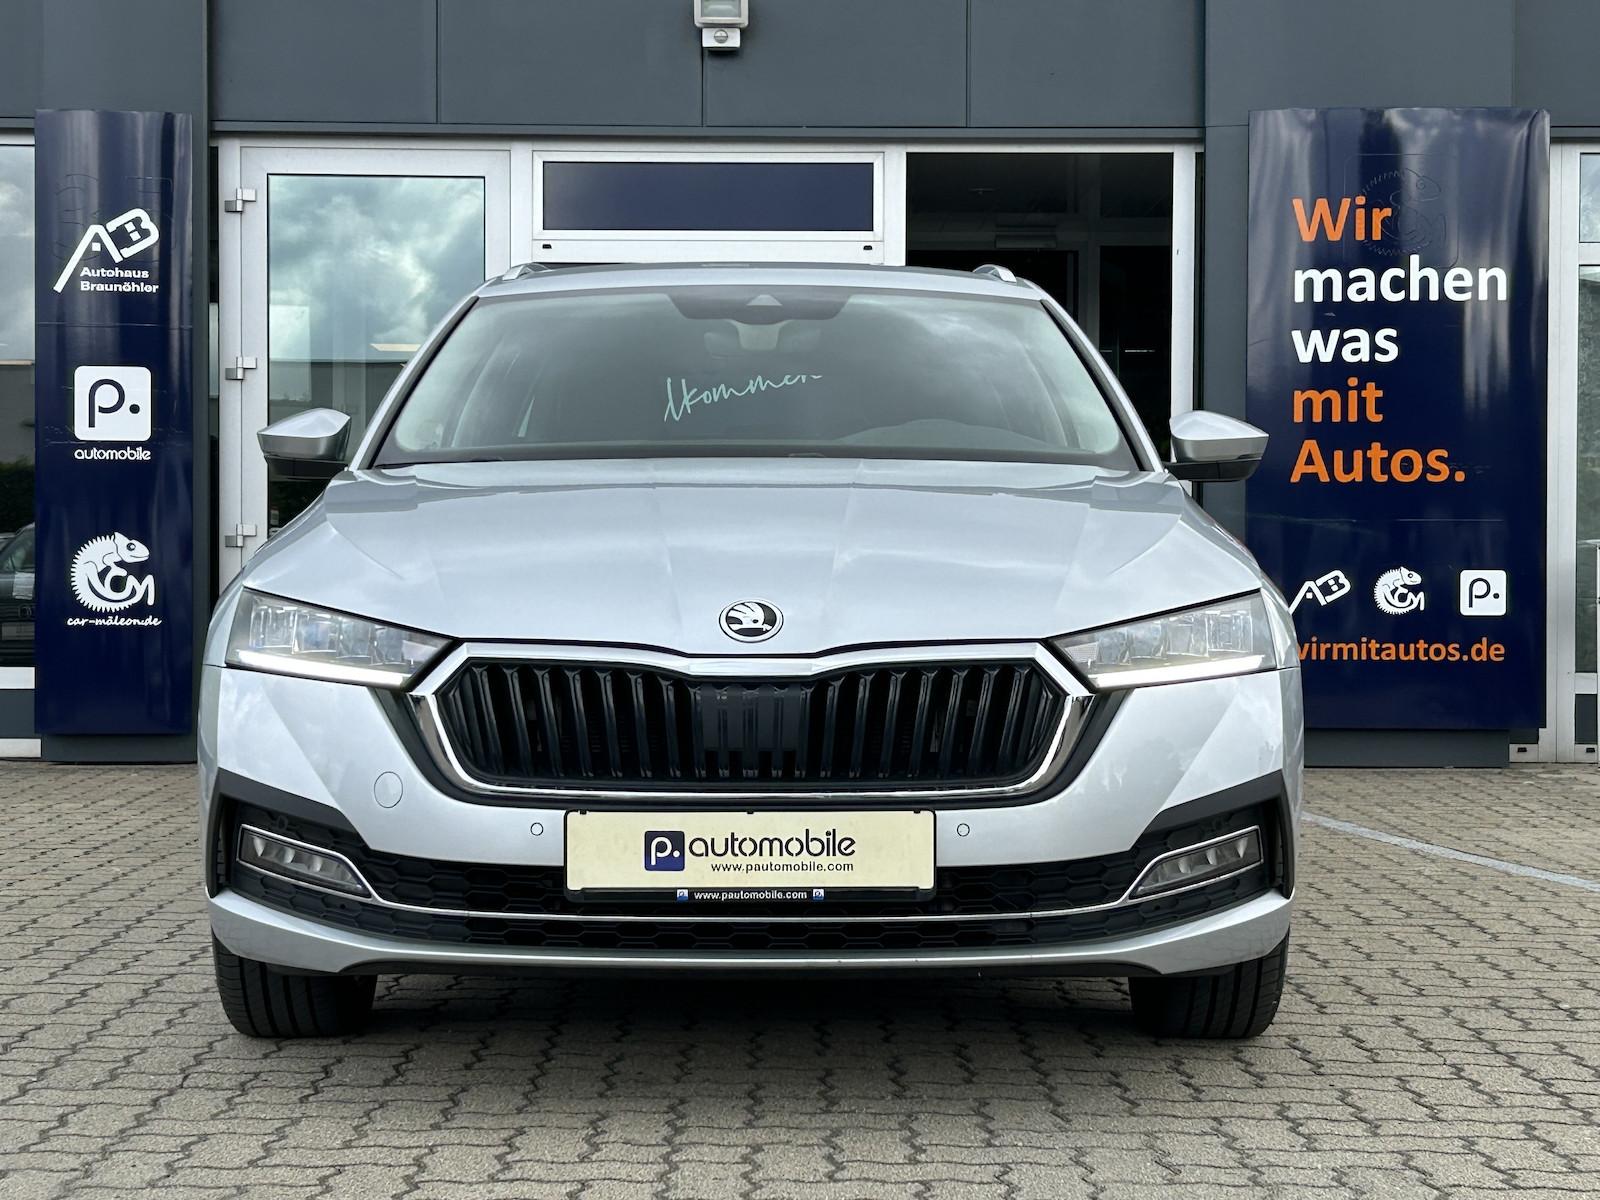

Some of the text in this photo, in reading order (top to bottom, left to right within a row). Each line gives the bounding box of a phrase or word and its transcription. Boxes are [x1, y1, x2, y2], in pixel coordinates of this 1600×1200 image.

[1292, 195, 1392, 241] Wir
[80, 266, 150, 279] Autohaus
[1294, 254, 1507, 302] machen
[1291, 327, 1399, 363] was
[1293, 376, 1384, 423] mit
[74, 446, 151, 460] automobile
[1290, 439, 1466, 483] Autos.
[688, 828, 856, 857] automobile
[711, 861, 854, 873] www.pautomobile.com
[694, 890, 808, 901] www.pautomobile.com
